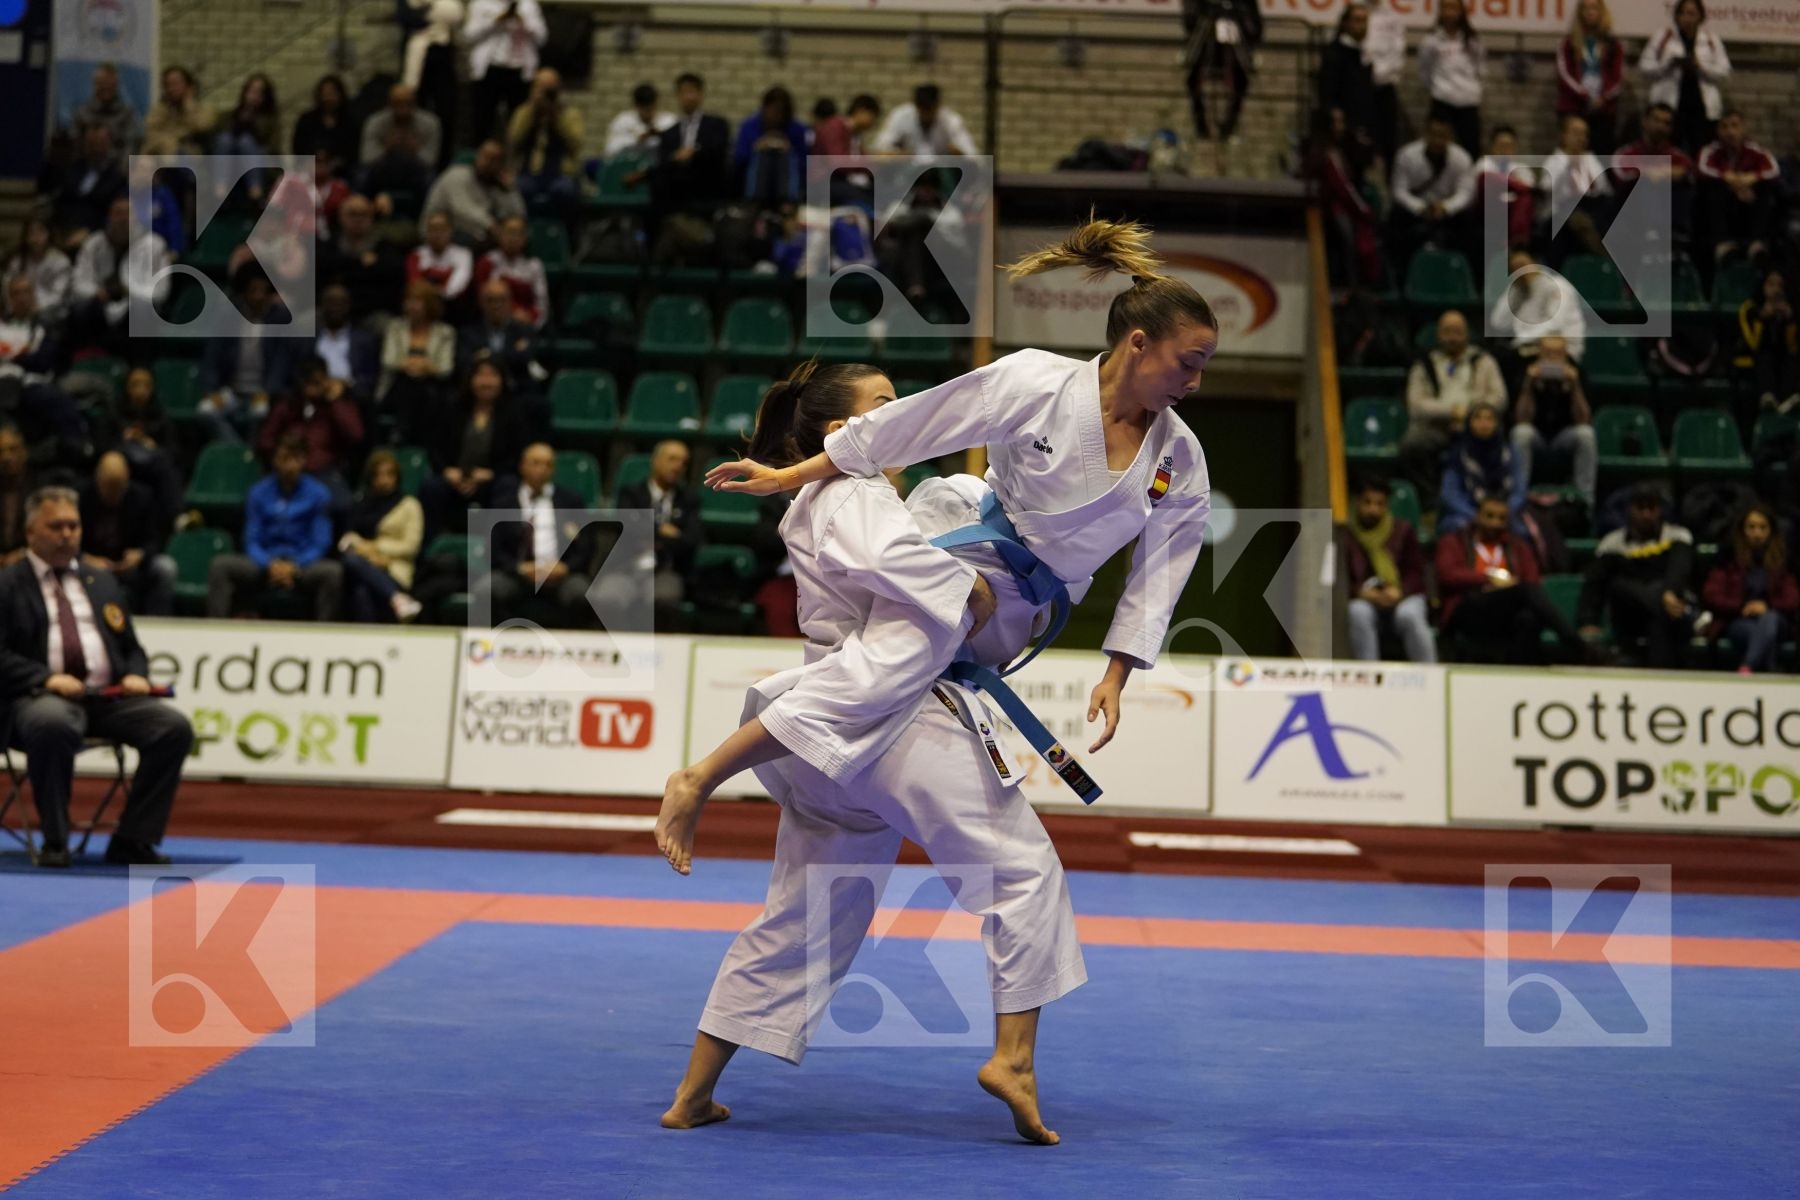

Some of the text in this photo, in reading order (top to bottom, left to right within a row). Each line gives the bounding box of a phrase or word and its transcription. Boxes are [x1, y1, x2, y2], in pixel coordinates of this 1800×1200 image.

[148, 646, 385, 697] erdam
[463, 691, 572, 719] Karate
[592, 703, 644, 744] Tv
[1511, 691, 1800, 749] rotterda
[1513, 755, 1800, 816] TOPSPO
